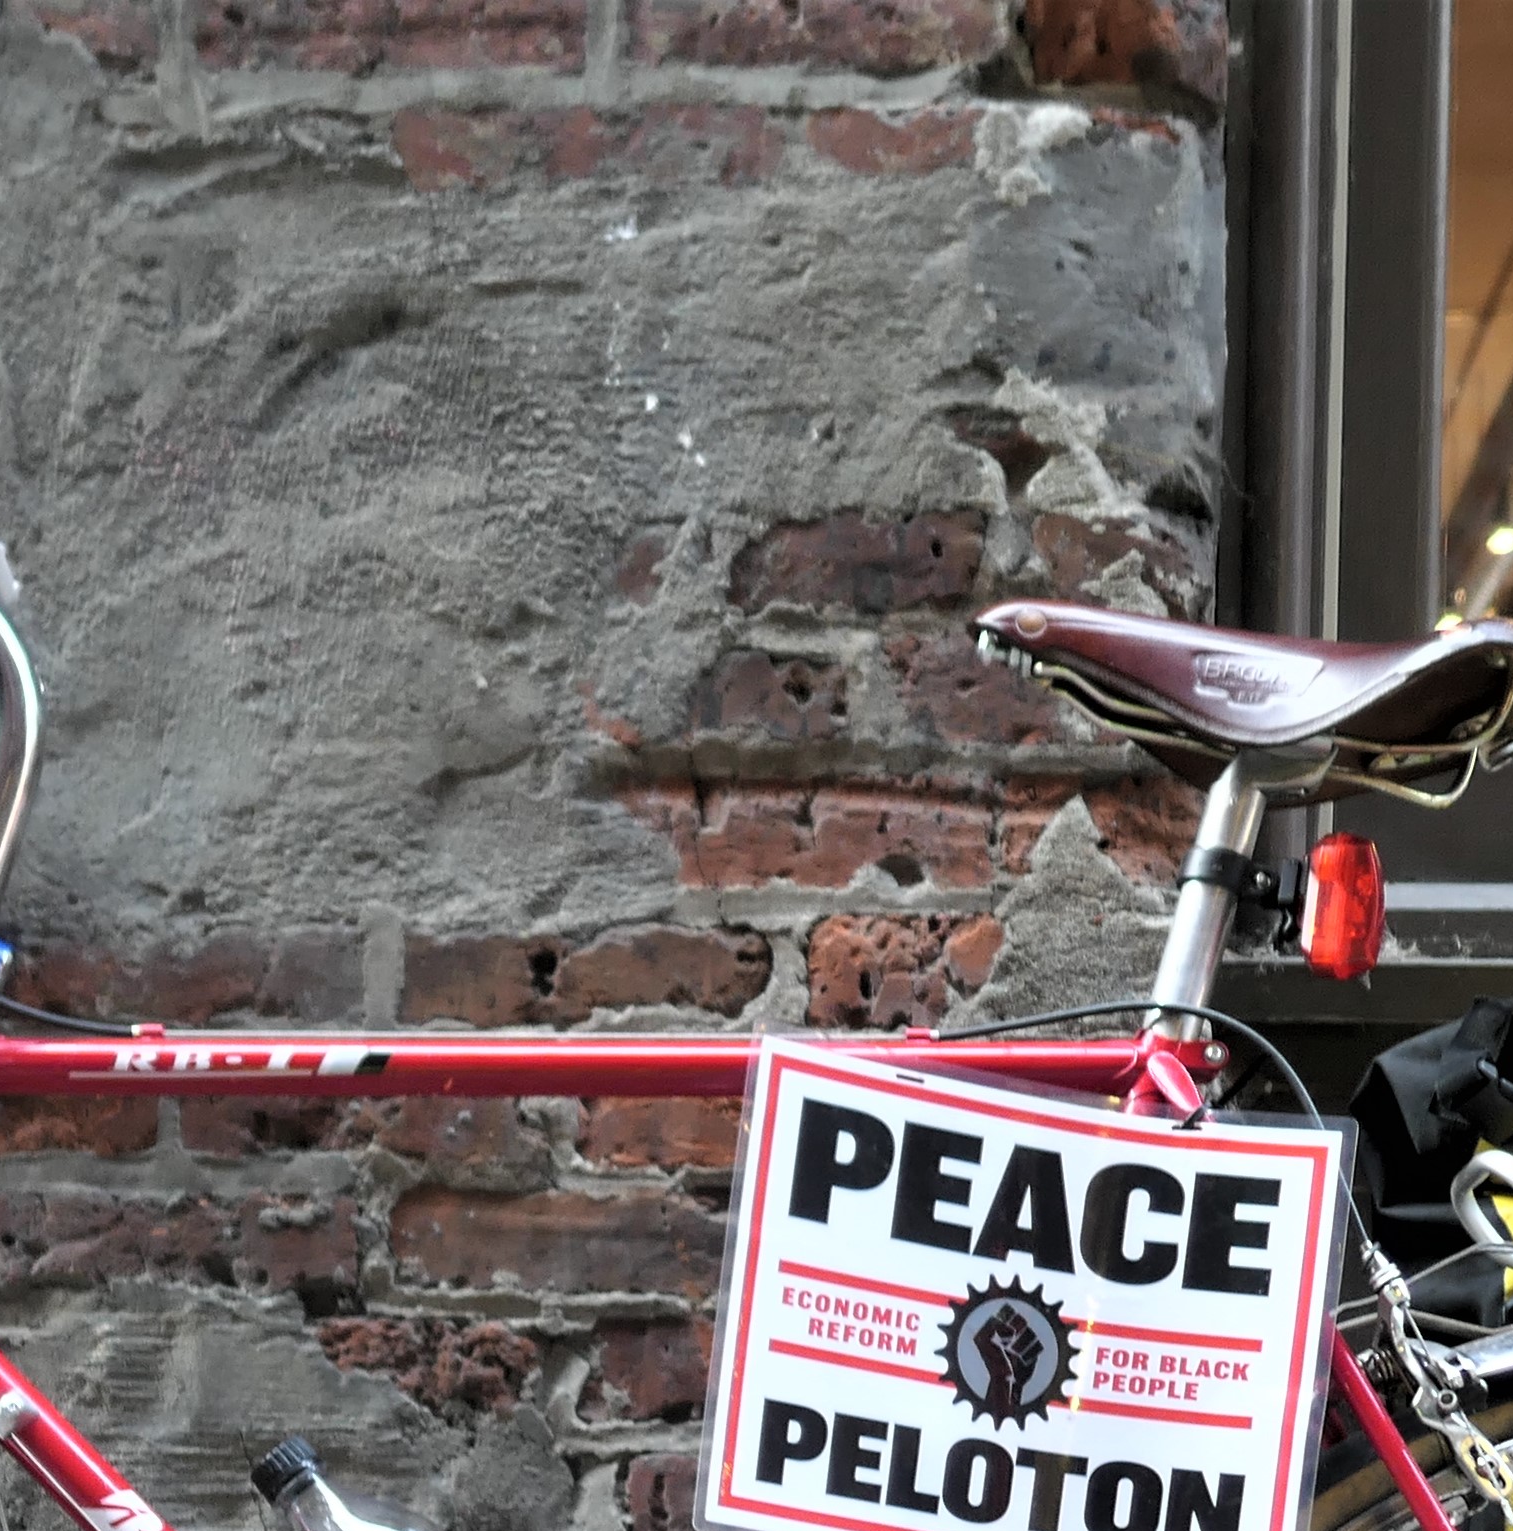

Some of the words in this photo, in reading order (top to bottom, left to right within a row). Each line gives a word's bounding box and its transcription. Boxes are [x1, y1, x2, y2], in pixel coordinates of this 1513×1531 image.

[788, 1096, 1282, 1297] PEACE
[782, 1286, 921, 1332] ECONOMIC
[808, 1317, 918, 1356] REFORM
[1095, 1346, 1150, 1371] FOR
[1159, 1354, 1250, 1381] BLACK
[1092, 1370, 1199, 1401] PEOPLE
